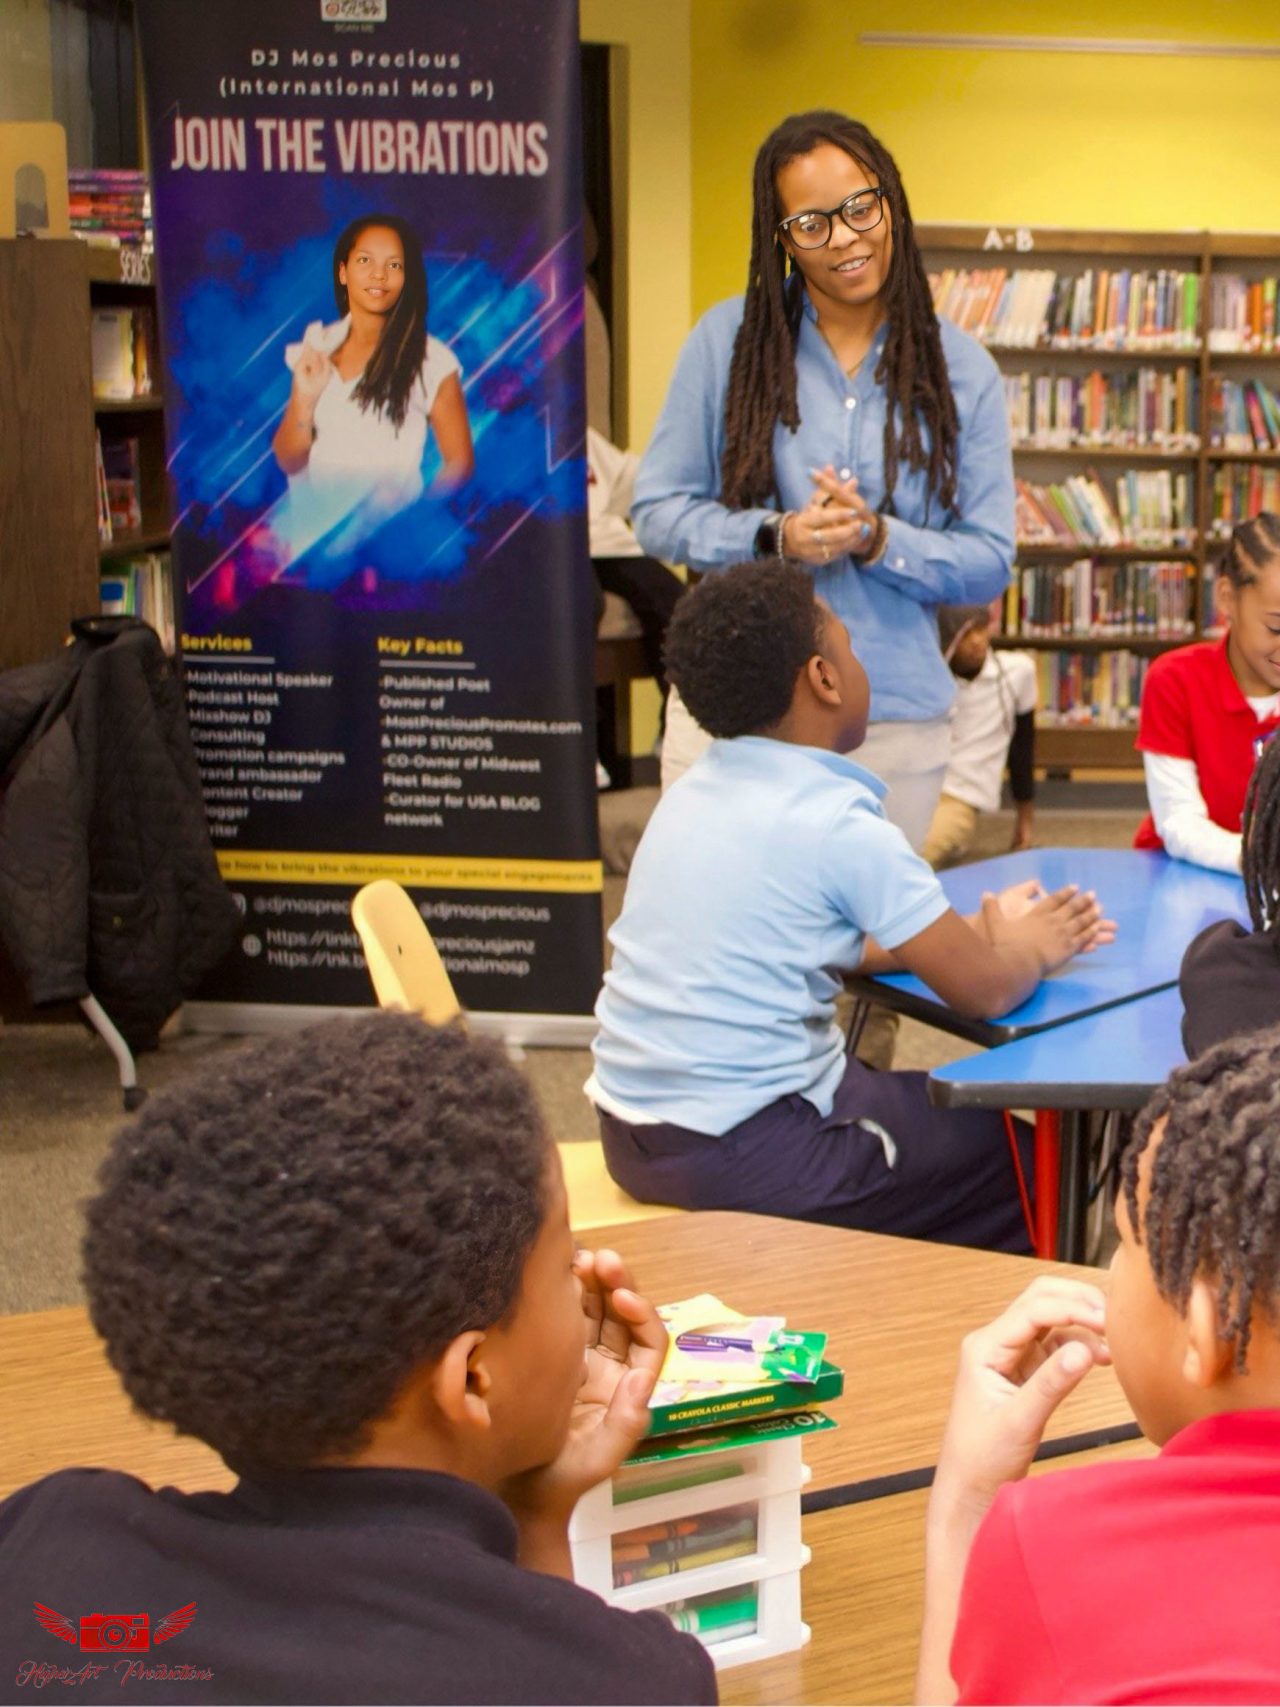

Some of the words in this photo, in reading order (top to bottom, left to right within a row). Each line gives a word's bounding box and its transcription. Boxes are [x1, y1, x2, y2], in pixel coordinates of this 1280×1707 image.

[251, 50, 279, 67] DJ
[292, 50, 339, 67] Mos
[351, 50, 461, 68] Precious
[219, 76, 399, 98] (International
[411, 79, 458, 98] Mos
[470, 80, 495, 101] P)
[171, 117, 247, 171] JOIN
[254, 118, 326, 172] THE
[334, 120, 549, 177] VIBRATIONS
[377, 636, 411, 656] Key
[415, 638, 463, 655] Facts
[276, 673, 334, 688] Speaker
[430, 736, 494, 751] STUDIOS
[268, 750, 346, 767] campaigns
[199, 768, 234, 781] rand
[202, 787, 248, 799] ontent
[677, 1406, 712, 1419] CRAYOLA
[712, 1399, 745, 1413] CLASSIC
[742, 1395, 775, 1409] MARKERS
